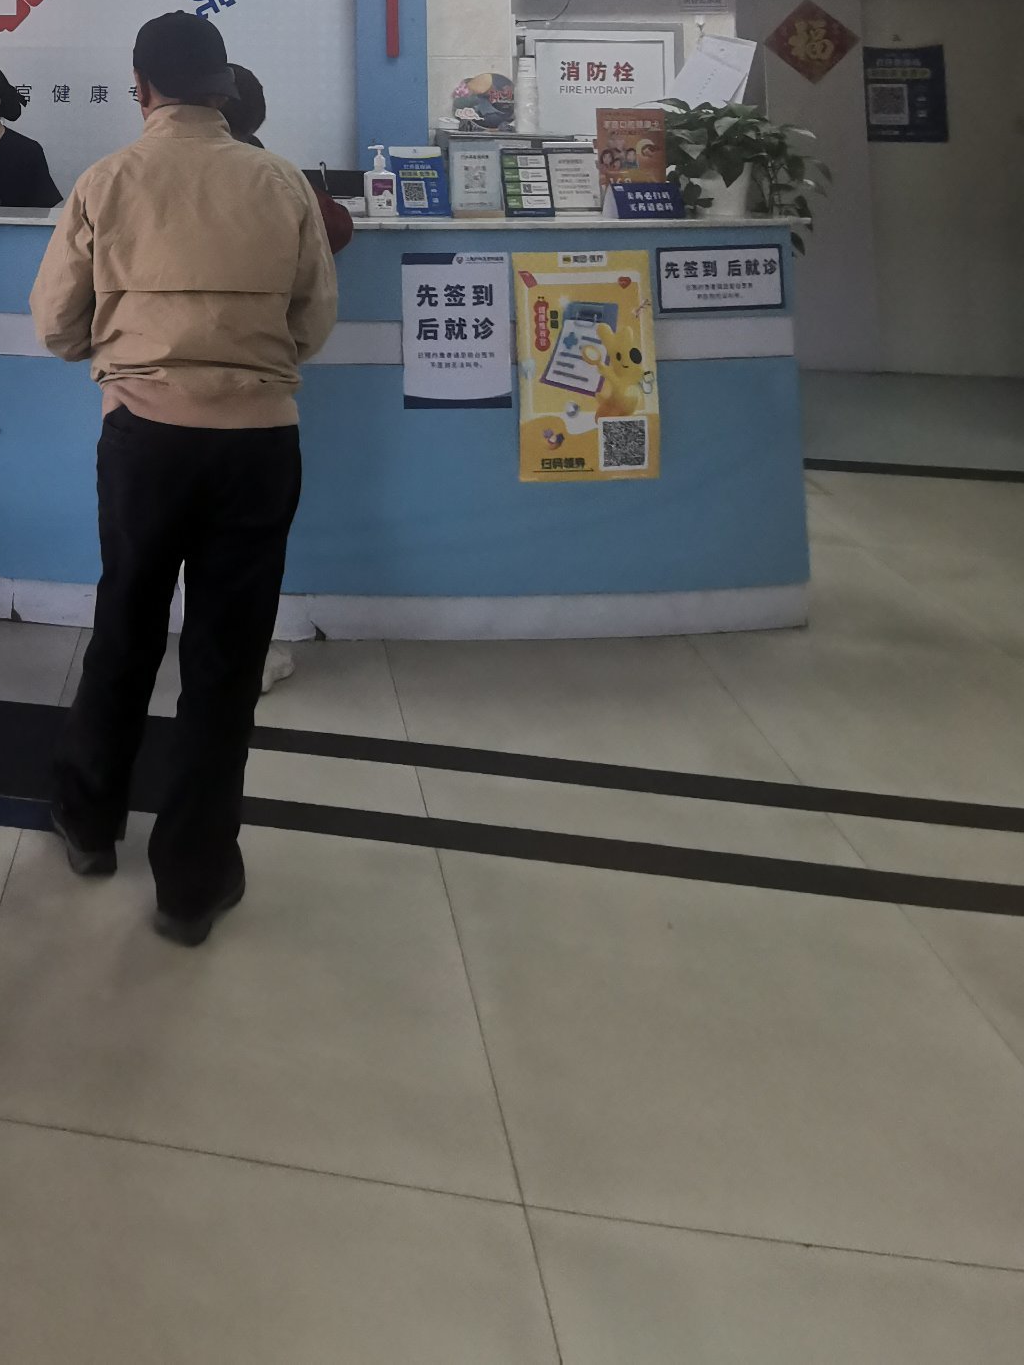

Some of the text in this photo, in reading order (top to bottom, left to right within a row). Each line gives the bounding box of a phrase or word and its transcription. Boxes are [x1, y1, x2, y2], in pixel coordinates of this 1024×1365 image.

[560, 61, 635, 82] 消防栓
[559, 85, 634, 95] FIRE HYDRANT
[665, 258, 778, 279] 先签到 后就诊
[416, 283, 494, 307] 先签到
[416, 317, 495, 341] 后就诊
